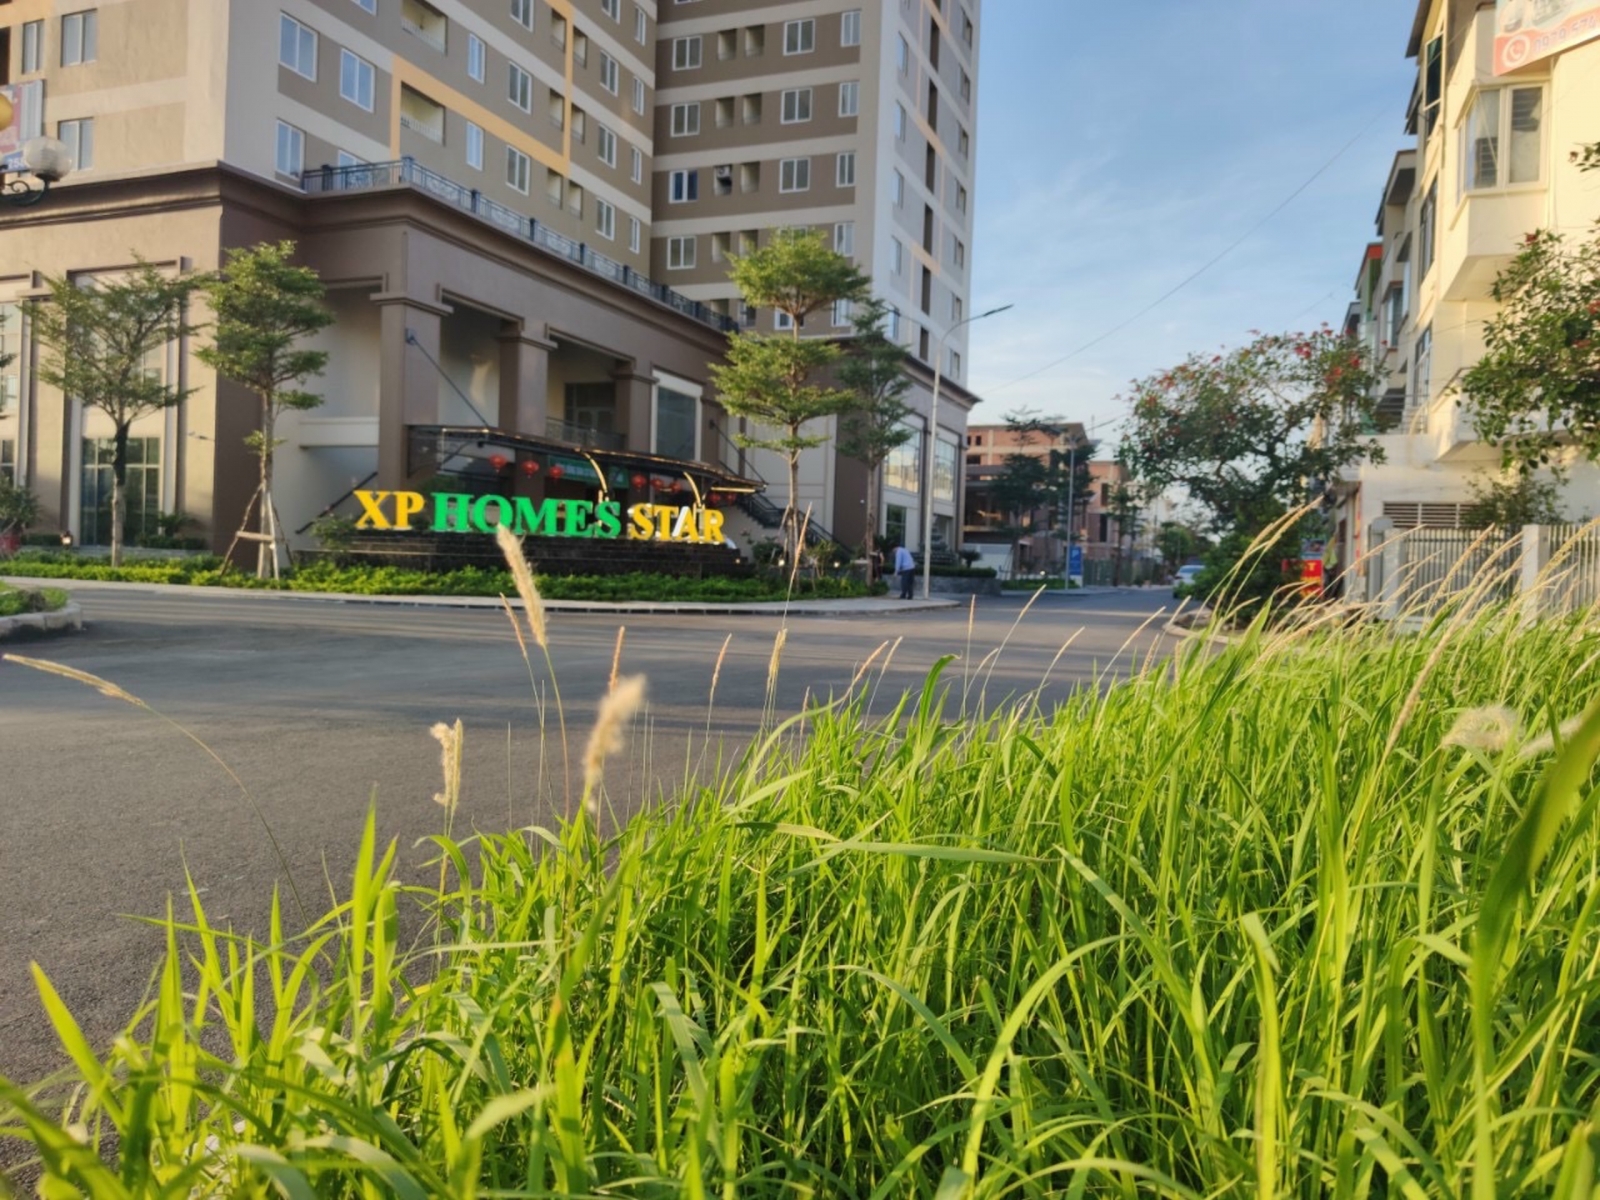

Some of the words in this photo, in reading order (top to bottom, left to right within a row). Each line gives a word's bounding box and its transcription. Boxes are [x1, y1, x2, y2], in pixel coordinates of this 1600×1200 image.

[353, 489, 425, 531] XP
[430, 491, 621, 539] HOMES
[627, 502, 724, 544] STAR
